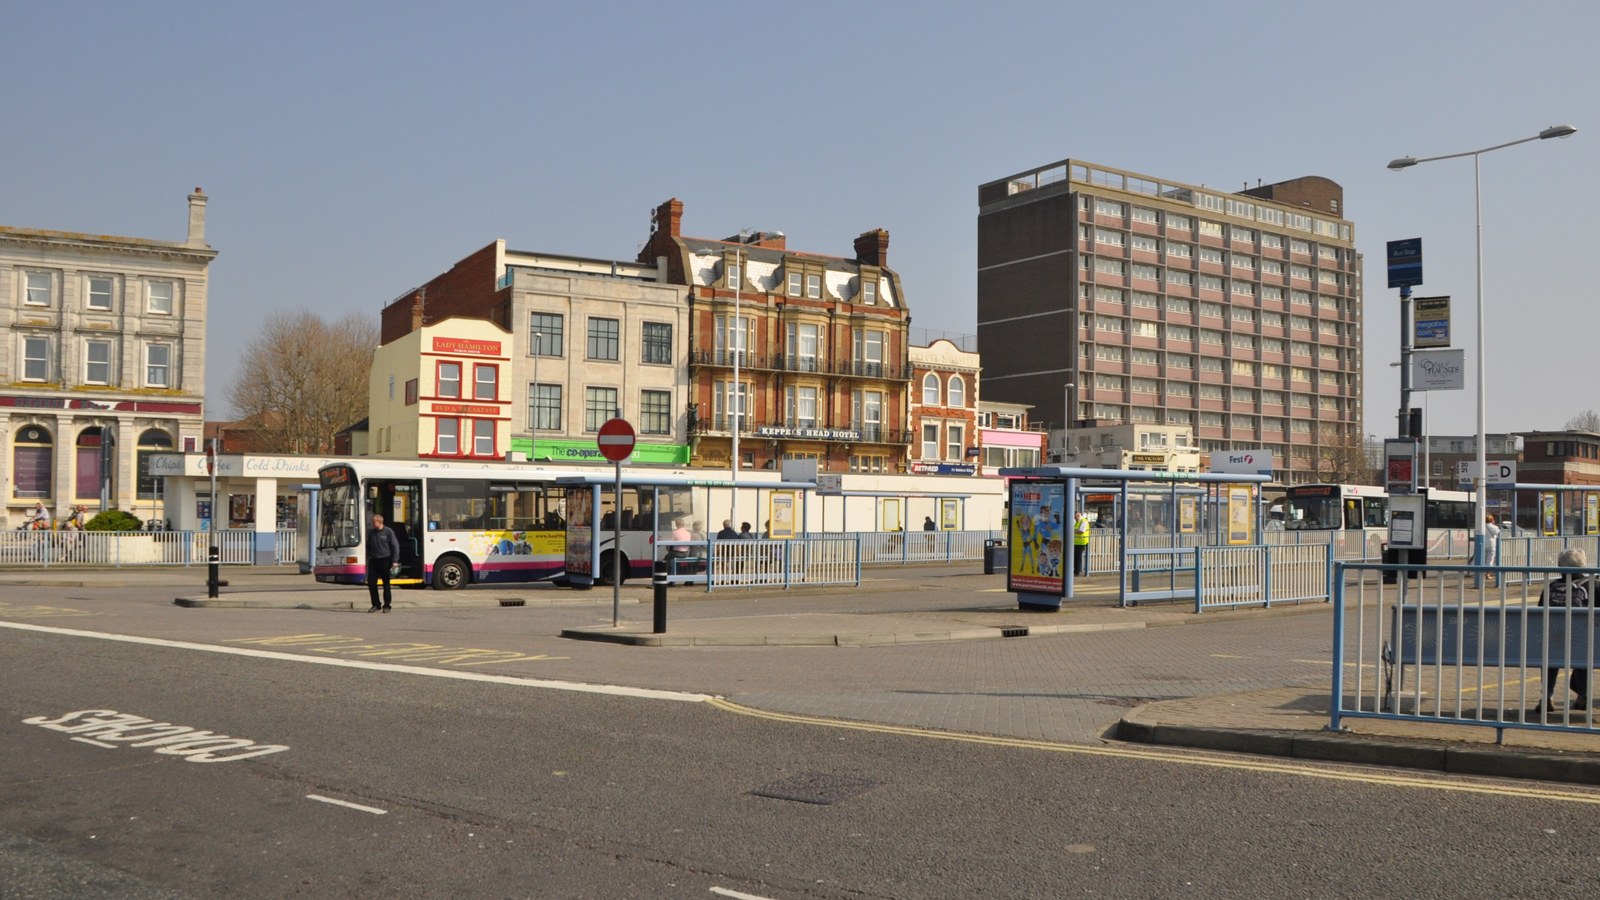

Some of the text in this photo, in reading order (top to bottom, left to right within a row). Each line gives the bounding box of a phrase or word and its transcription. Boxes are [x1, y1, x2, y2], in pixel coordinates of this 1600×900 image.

[436, 341, 499, 352] LADY HAMILTON
[460, 406, 497, 414] BREAKFAST
[806, 429, 830, 437] HEAD
[833, 431, 860, 439] HOTEL
[552, 446, 566, 456] The
[155, 456, 182, 471] Chips
[246, 458, 270, 472] Cold
[272, 459, 310, 472] Drinks
[1229, 456, 1244, 464] First
[1500, 465, 1511, 478] D
[221, 633, 571, 666] NO ENTRY
[21, 709, 290, 763] COACHES
